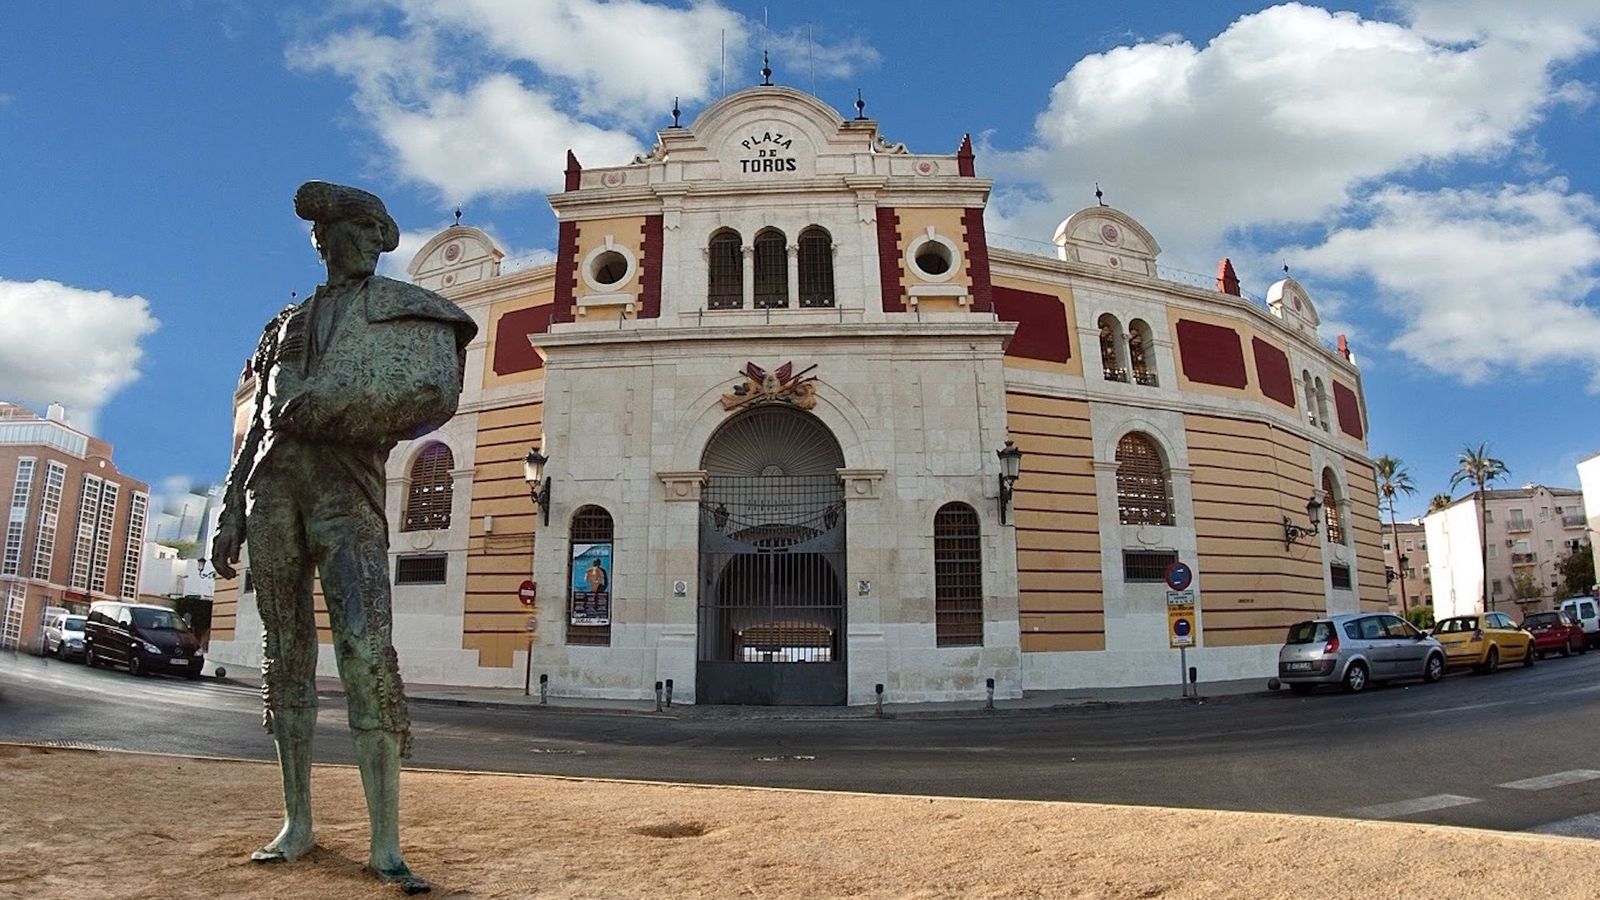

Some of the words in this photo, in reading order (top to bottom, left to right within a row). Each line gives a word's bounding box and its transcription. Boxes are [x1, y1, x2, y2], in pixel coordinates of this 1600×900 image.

[741, 132, 792, 150] PLAZA
[758, 149, 777, 157] DE
[740, 158, 796, 173] TOROS
